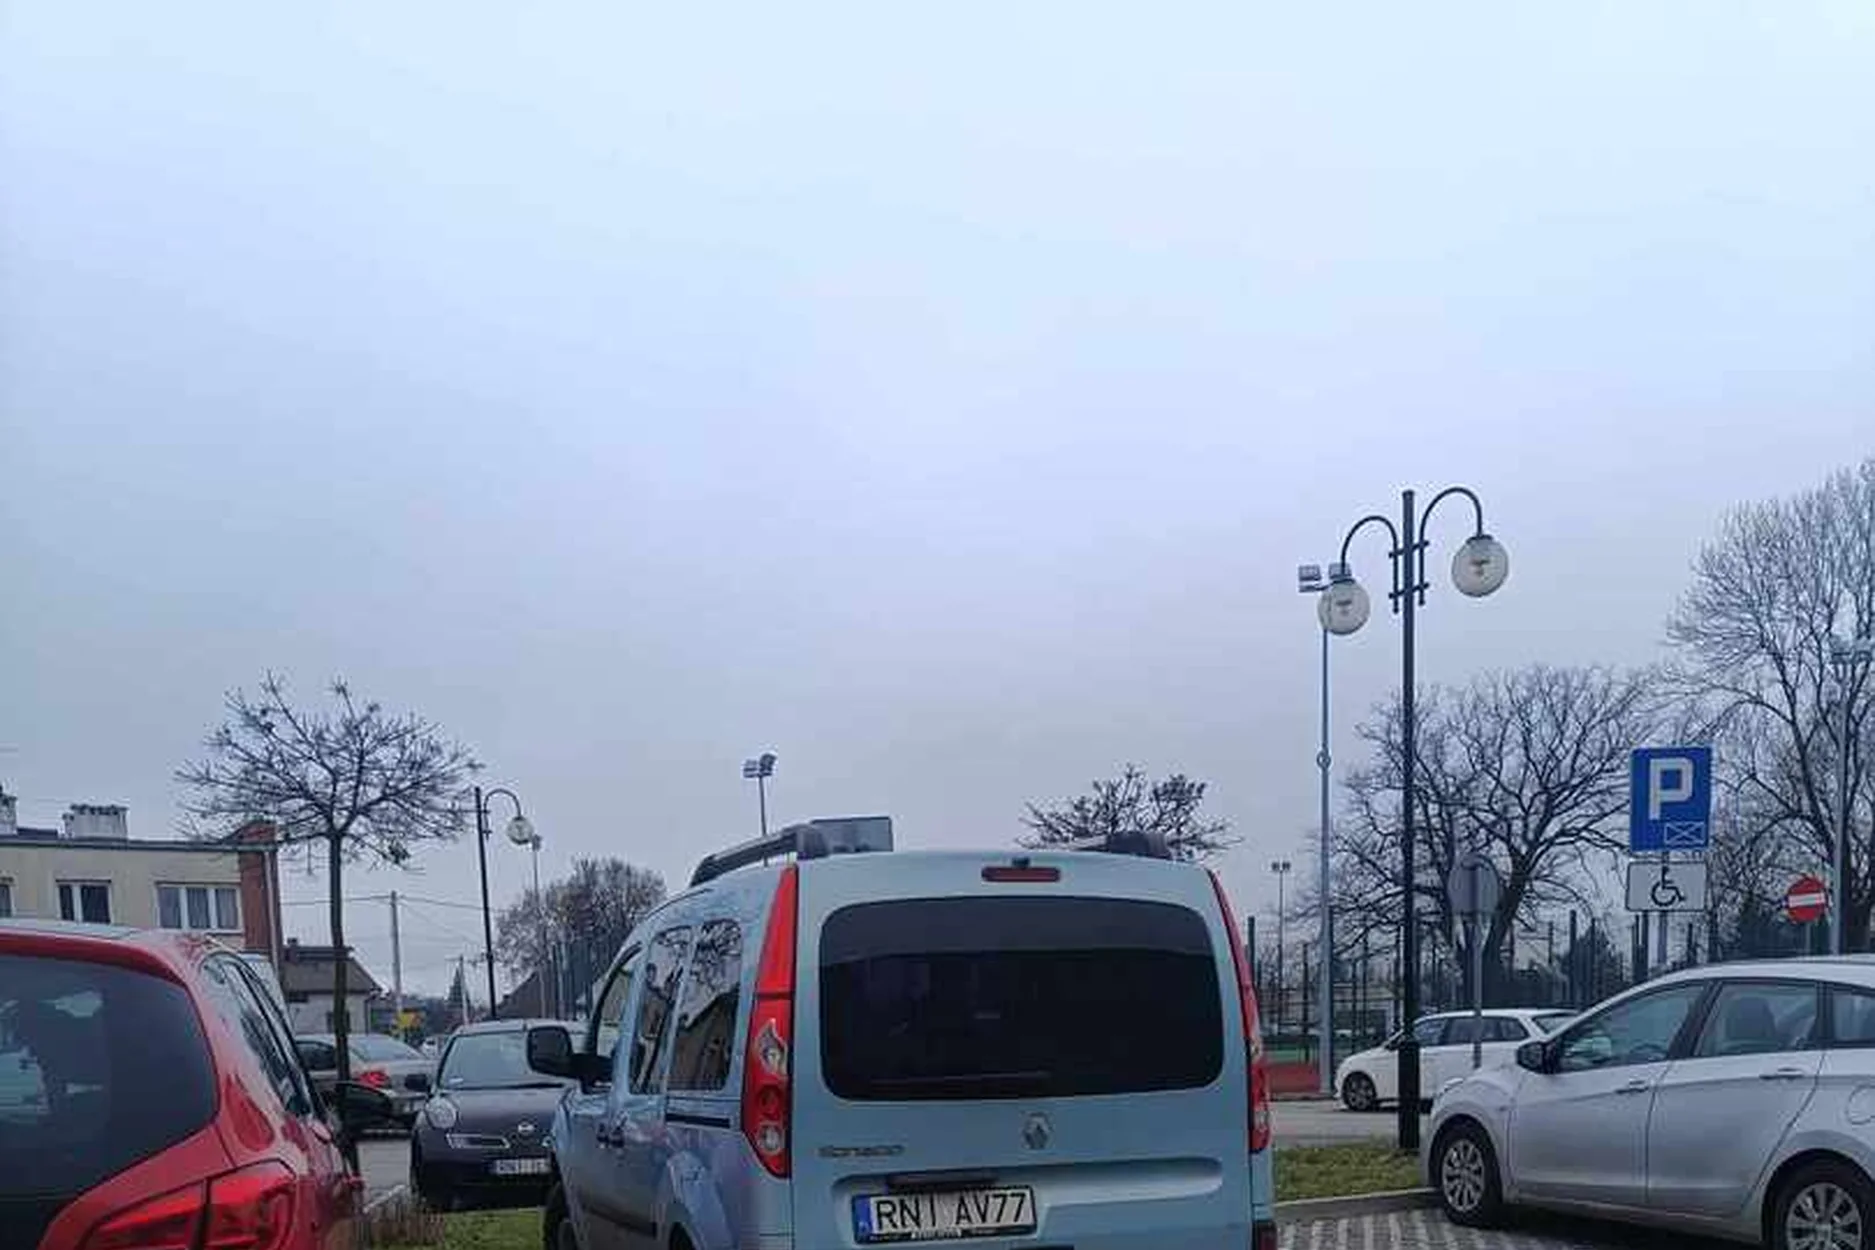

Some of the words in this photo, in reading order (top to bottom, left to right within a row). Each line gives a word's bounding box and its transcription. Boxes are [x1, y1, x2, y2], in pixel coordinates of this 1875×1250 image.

[1649, 757, 1694, 821] P
[877, 1194, 936, 1229] RNI
[955, 1193, 1025, 1225] AV77
